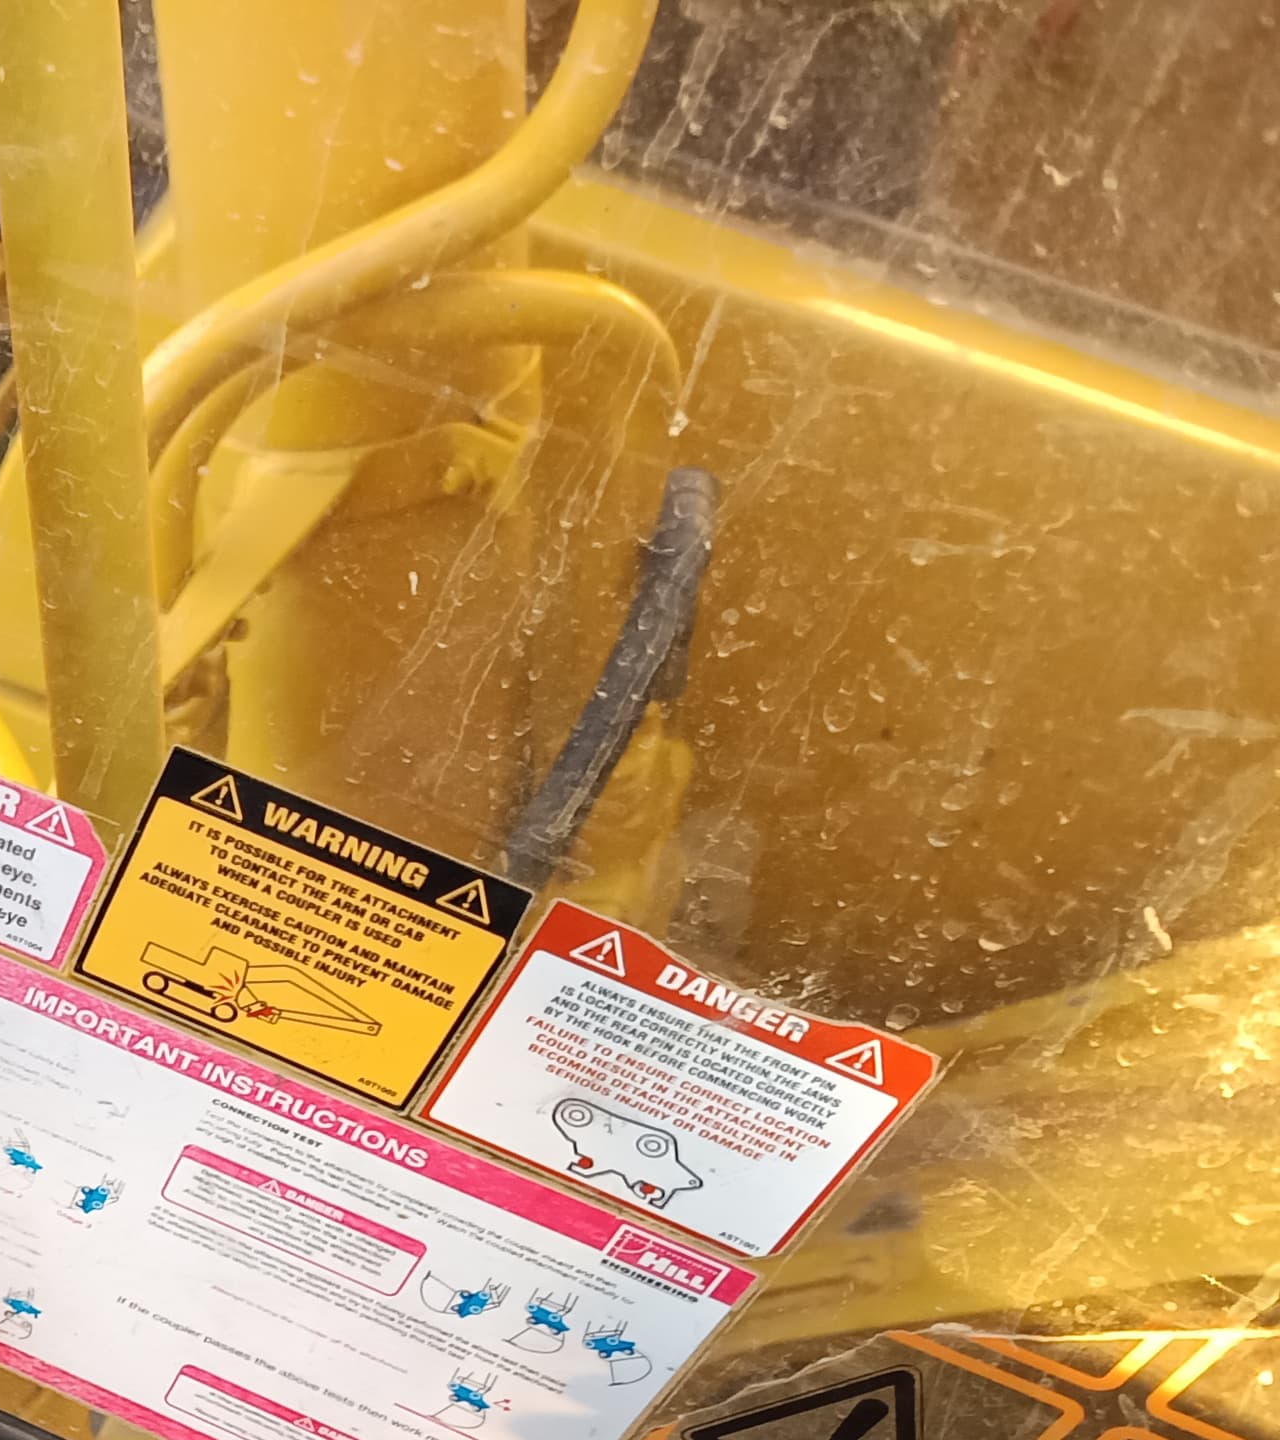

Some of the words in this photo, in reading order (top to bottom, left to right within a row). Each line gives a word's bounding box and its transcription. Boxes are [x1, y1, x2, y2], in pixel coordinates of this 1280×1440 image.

[188, 820, 204, 835] IT
[205, 827, 221, 842] IS
[223, 834, 294, 872] POSSIBLE
[295, 864, 327, 885] FOR
[328, 878, 359, 899] THE
[359, 891, 461, 941] ATTACHMENT
[208, 845, 228, 861] TO
[229, 854, 297, 889] CONTACT
[300, 883, 329, 903] THE
[330, 895, 367, 918] ARM
[369, 911, 390, 928] OR
[392, 921, 425, 943] CAB
[258, 800, 430, 891] WARNING
[138, 871, 212, 909] ADEQUATE
[213, 902, 298, 945] CLEARANCE
[299, 938, 321, 955] TO
[321, 947, 389, 984] PREVENT
[390, 976, 454, 1011] DAMAGE
[151, 860, 209, 892] ALWAYS
[210, 885, 281, 922] EXERCISE
[282, 915, 347, 950] CAUTION
[348, 942, 381, 964] AND
[381, 956, 455, 995] MAINTAIN
[210, 915, 241, 936] AND
[242, 929, 311, 965] POSSIBLE
[313, 958, 367, 988] INJURY
[215, 864, 259, 889] WHEN
[261, 882, 274, 896] A
[275, 889, 343, 924] COUPLER
[344, 917, 361, 932] IS
[362, 924, 403, 949] USED
[550, 993, 577, 1012] AND
[578, 1004, 605, 1023] THE
[609, 1018, 648, 1042] REAR
[649, 1034, 675, 1053] PIN
[675, 1045, 692, 1060] IS
[692, 1053, 754, 1086] LOCATED
[754, 1079, 836, 1121] CORRECTLY
[559, 983, 576, 997] IS
[576, 990, 638, 1023] LOCATED
[638, 1017, 718, 1057] CORRECTLY
[719, 1050, 771, 1079] WITHIN
[772, 1073, 800, 1091] THE
[800, 1084, 842, 1109] JAWS
[580, 977, 637, 1008] ALWAYS
[637, 1001, 694, 1032] ENSURE
[696, 1026, 730, 1048] THAT
[732, 1041, 759, 1060] THE
[761, 1054, 809, 1081] FRONT
[809, 1074, 836, 1093] PIN
[654, 962, 810, 1046] DANGER
[20, 984, 195, 1072] IMPORTANT
[197, 1057, 431, 1172] INSTRUCTIONS
[210, 1096, 290, 1136] CONNECTION
[290, 1130, 323, 1151] TEST
[525, 1012, 590, 1047] FAILURE
[591, 1040, 614, 1058] TO
[615, 1050, 678, 1085] ENSURE
[678, 1077, 752, 1117] CORRECT
[753, 1109, 831, 1150] LOCATION
[527, 1040, 608, 1082] BECOMING
[609, 1076, 698, 1121] DETACHED
[700, 1115, 777, 1154] RESULTING
[777, 1148, 797, 1163] IN
[535, 1030, 588, 1060] COULD
[589, 1054, 649, 1086] RESULT
[650, 1079, 670, 1096] IN
[671, 1088, 701, 1109] THE
[702, 1102, 805, 1153] ATTACHMENT
[542, 1003, 564, 1020] BY
[564, 1012, 592, 1032] THE
[592, 1024, 632, 1049] HOOK
[632, 1042, 686, 1071] BEFORE
[686, 1065, 781, 1111] COMMENCING
[782, 1105, 827, 1131] WORK
[544, 1061, 612, 1097] SERIOUS
[613, 1090, 670, 1122] INJURY
[671, 1115, 696, 1134] OR
[696, 1126, 764, 1162] DAMAGE
[284, 1188, 345, 1221] DANGER
[600, 1257, 699, 1304] ENGINEERING
[636, 1247, 710, 1292] HILL
[127, 1300, 151, 1317] the
[150, 1311, 202, 1339] coupler
[202, 1333, 252, 1362] passes
[252, 1355, 277, 1373] the
[277, 1367, 321, 1392] above
[321, 1386, 356, 1408] tests
[357, 1402, 389, 1423] then
[390, 1417, 422, 1438] work
